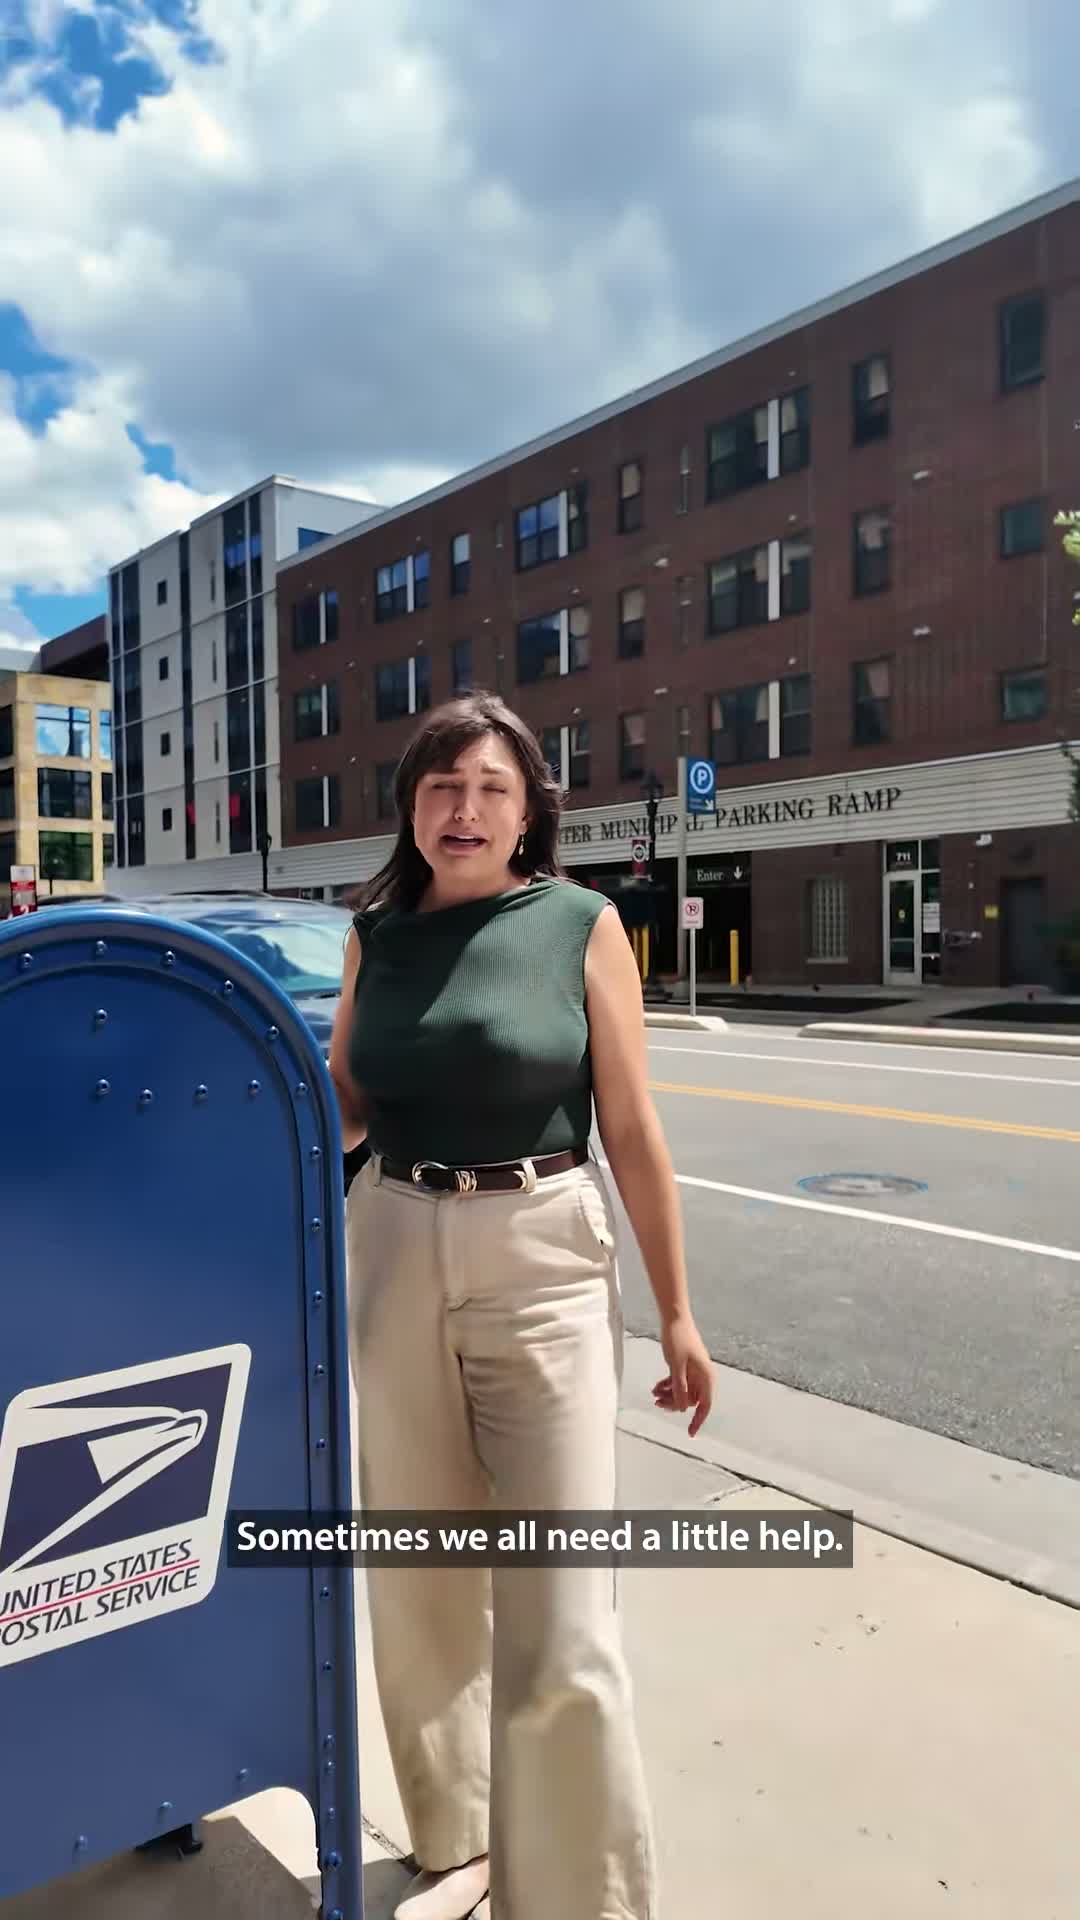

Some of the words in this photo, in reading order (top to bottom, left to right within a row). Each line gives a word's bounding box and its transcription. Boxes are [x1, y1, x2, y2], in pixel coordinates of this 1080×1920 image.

[697, 768, 708, 786] P
[560, 824, 592, 845] TER
[600, 814, 704, 841] MUNIIPL
[715, 798, 815, 829] PARKING
[827, 786, 901, 818] RAMP
[696, 868, 724, 882] Enter
[101, 1538, 192, 1581] STATES
[0, 1603, 89, 1646] OSTAL
[95, 1566, 200, 1618] SERVICE
